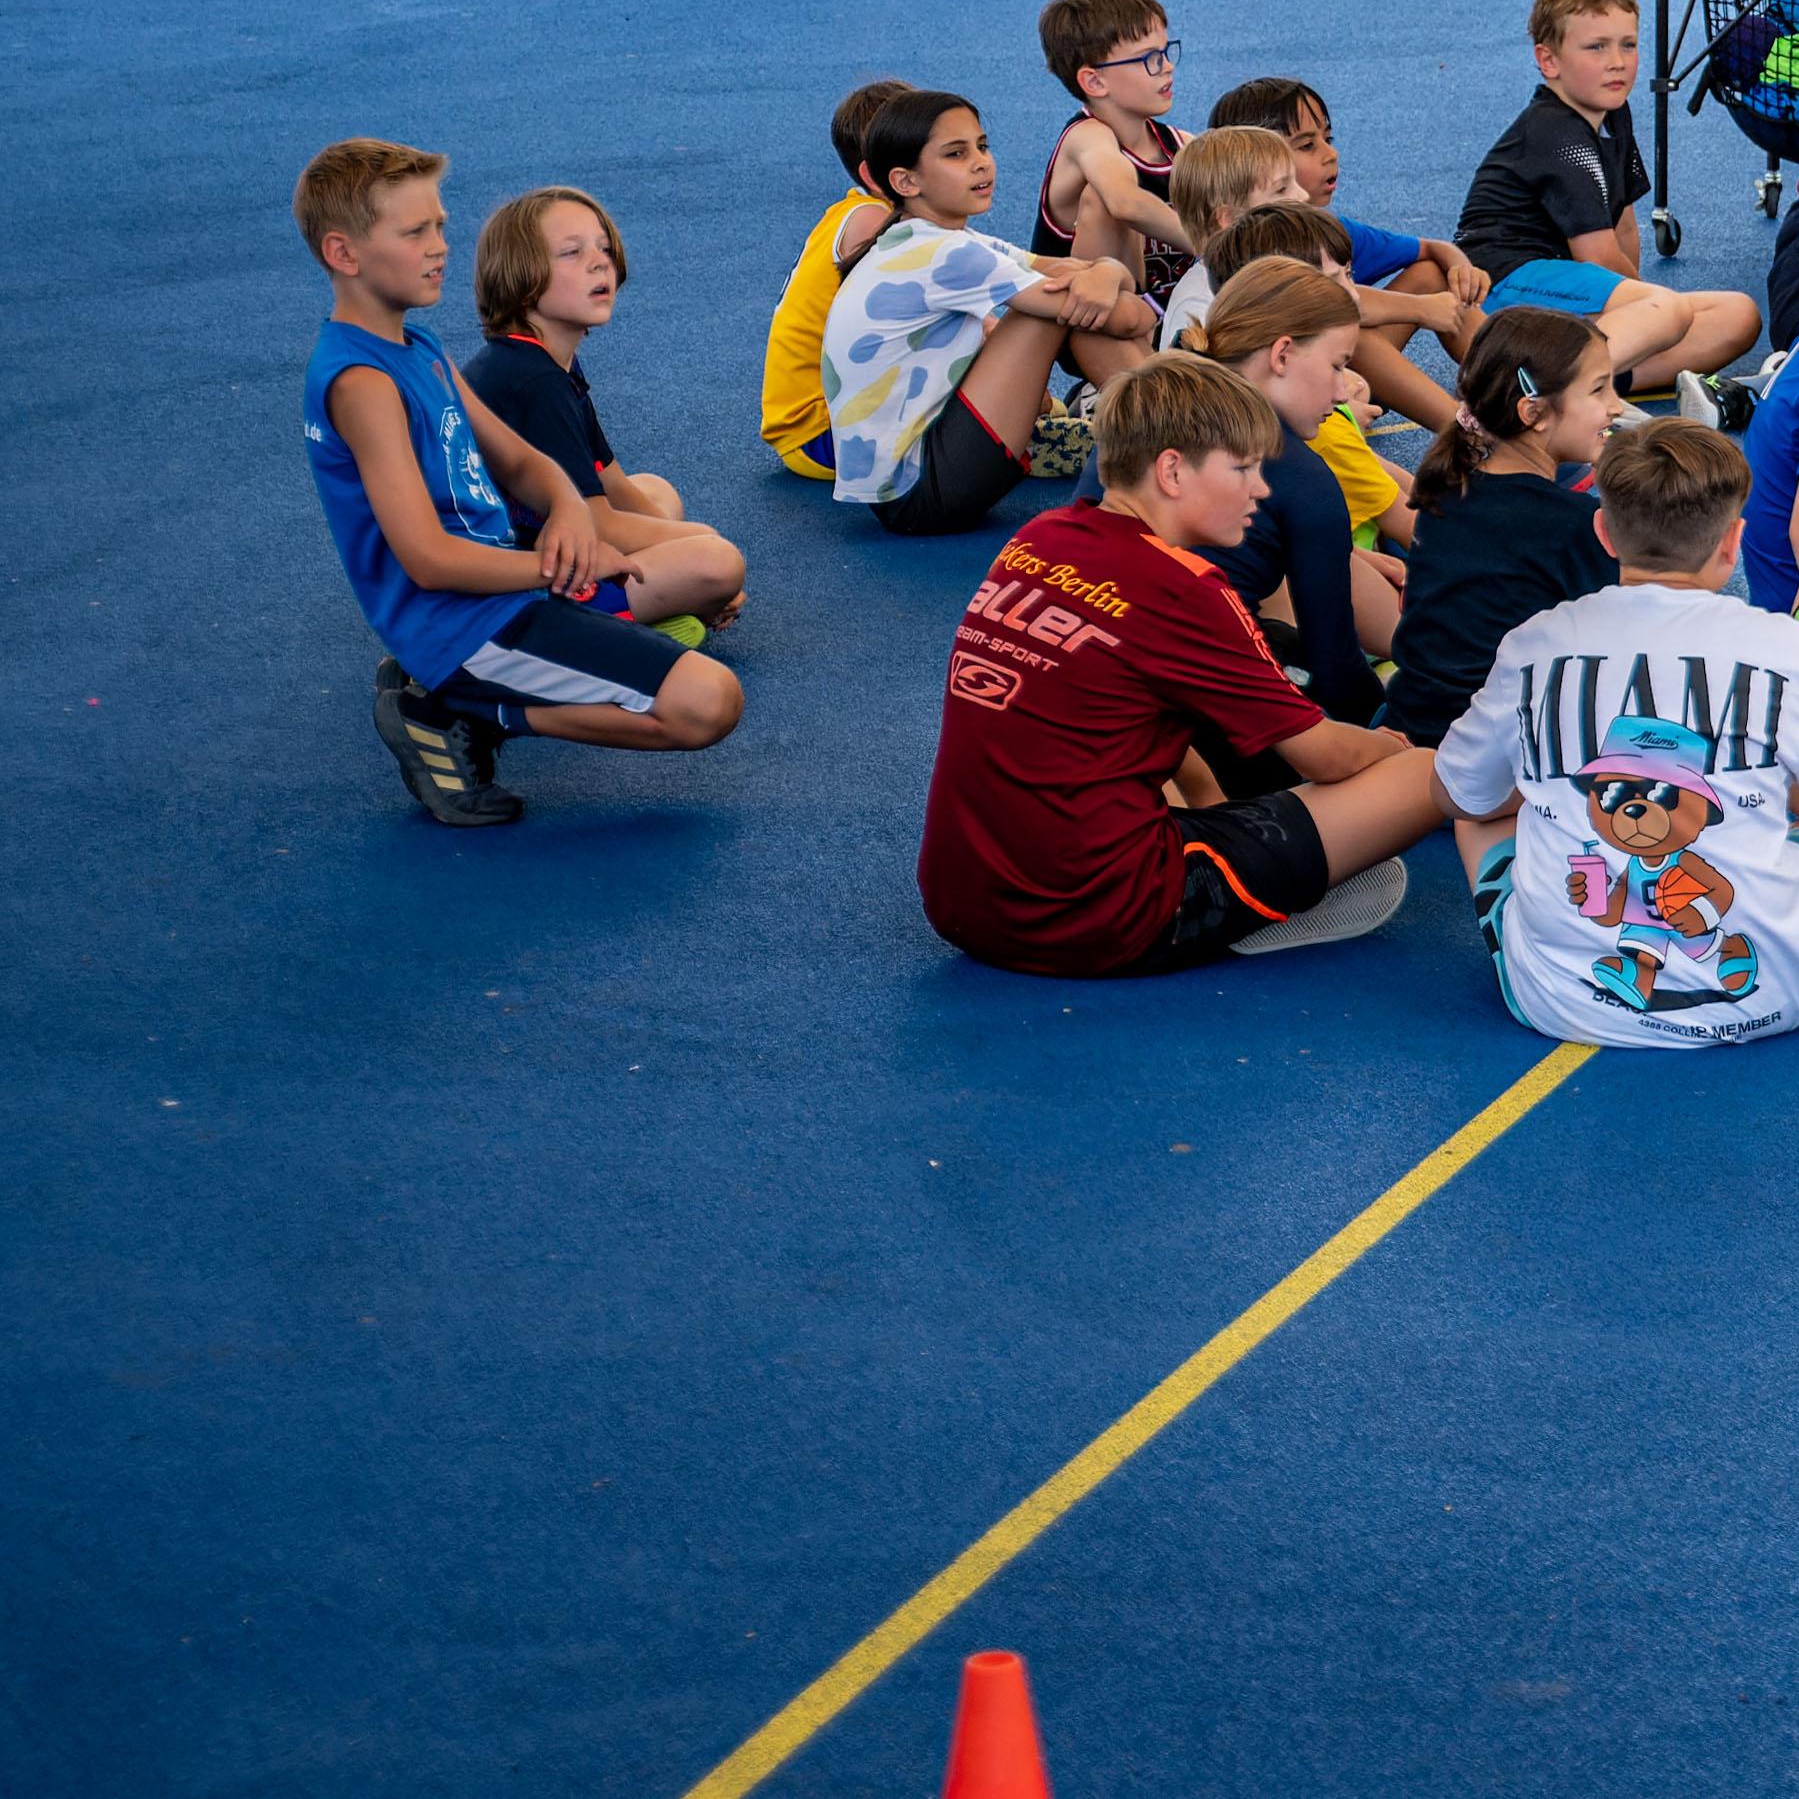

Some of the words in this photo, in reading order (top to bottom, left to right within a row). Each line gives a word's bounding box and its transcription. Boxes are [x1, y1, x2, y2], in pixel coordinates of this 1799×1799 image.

[1043, 563, 1132, 618] Berlin
[1629, 729, 1680, 751] Miami
[1712, 1011, 1782, 1040] MEMBER
